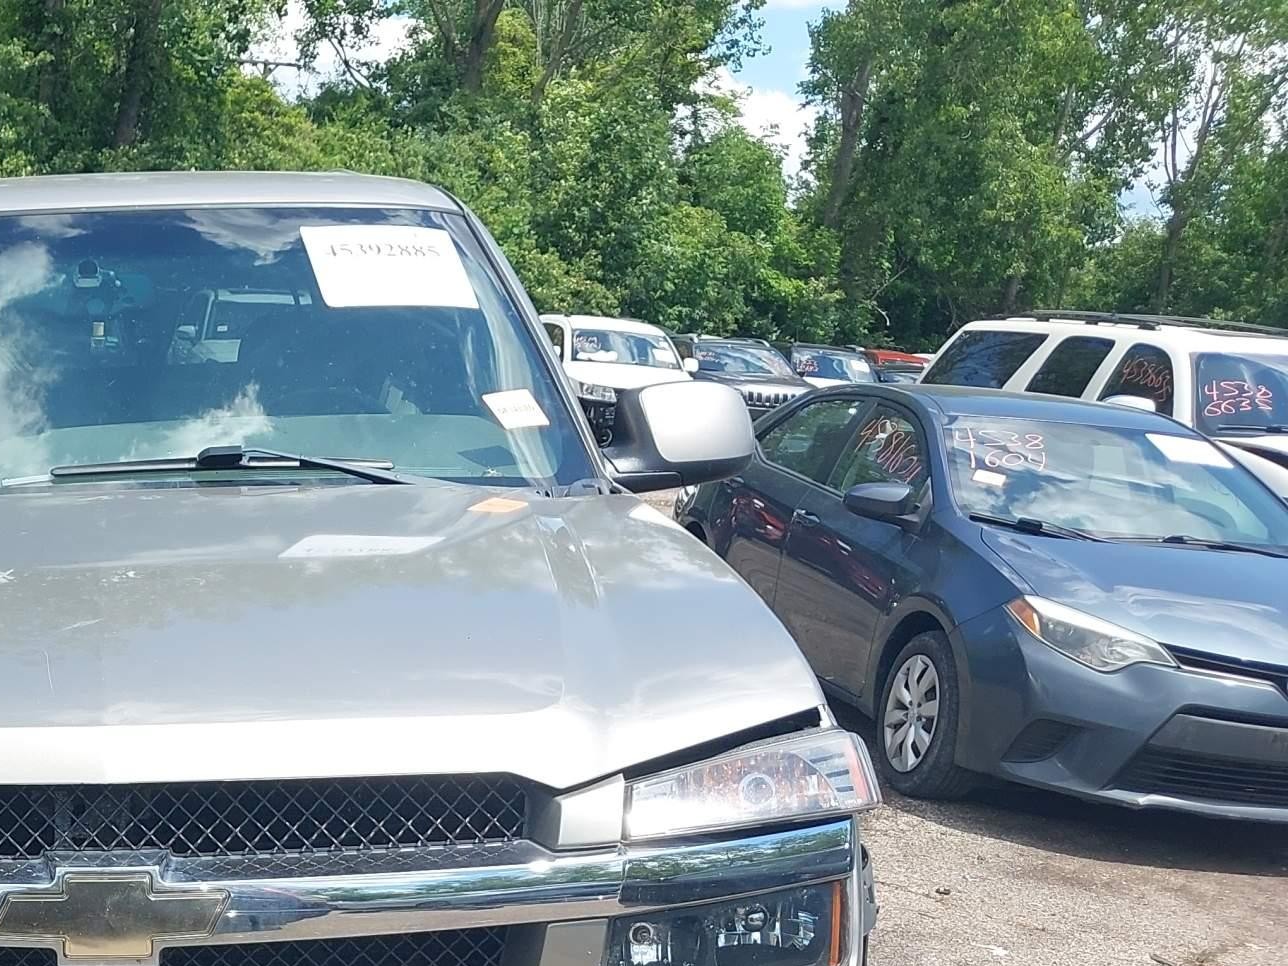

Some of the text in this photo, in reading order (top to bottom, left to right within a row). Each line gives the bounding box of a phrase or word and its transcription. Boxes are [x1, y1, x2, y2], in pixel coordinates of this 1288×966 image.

[325, 243, 441, 257] 45392885
[1204, 380, 1273, 401] 4538
[1204, 397, 1273, 417] 6635
[954, 426, 1046, 450] 4538
[969, 449, 1047, 472] 1604
